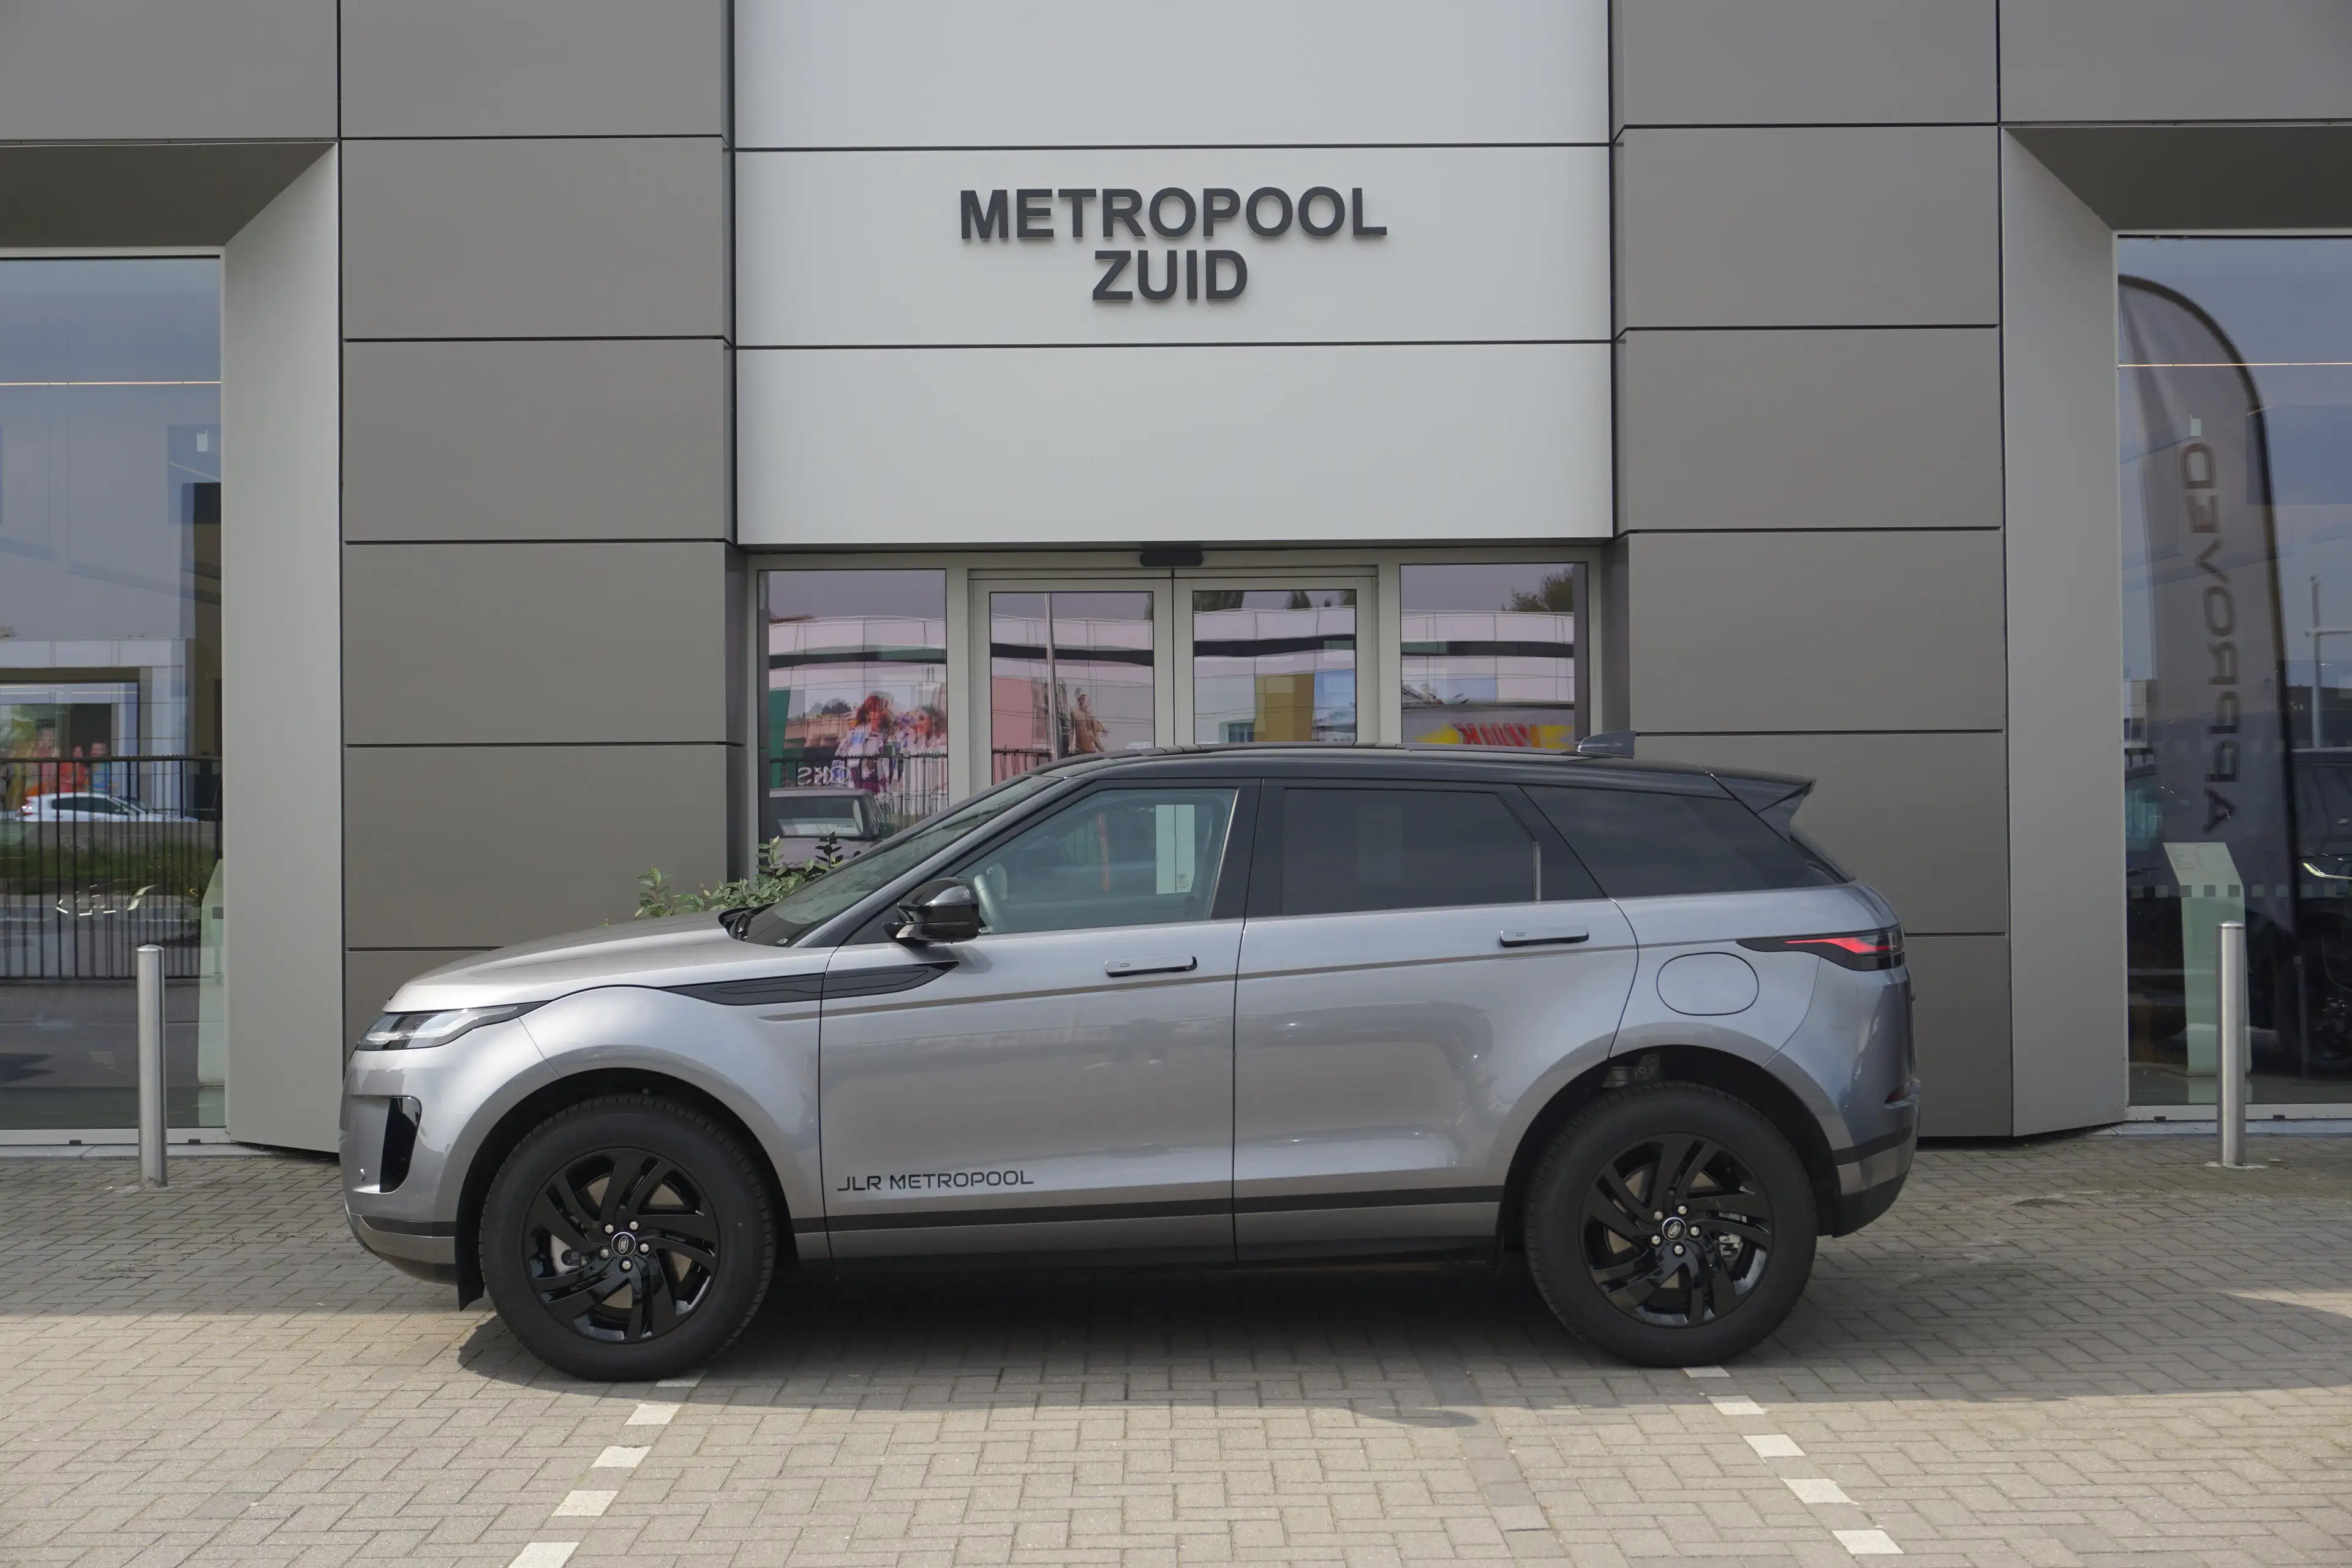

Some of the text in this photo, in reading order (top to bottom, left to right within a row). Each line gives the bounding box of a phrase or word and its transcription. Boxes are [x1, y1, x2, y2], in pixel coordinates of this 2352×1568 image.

[960, 186, 1387, 239] METROPOOL
[1092, 249, 1248, 300] ZUID
[837, 1170, 1034, 1191] JLR METROPOOL
